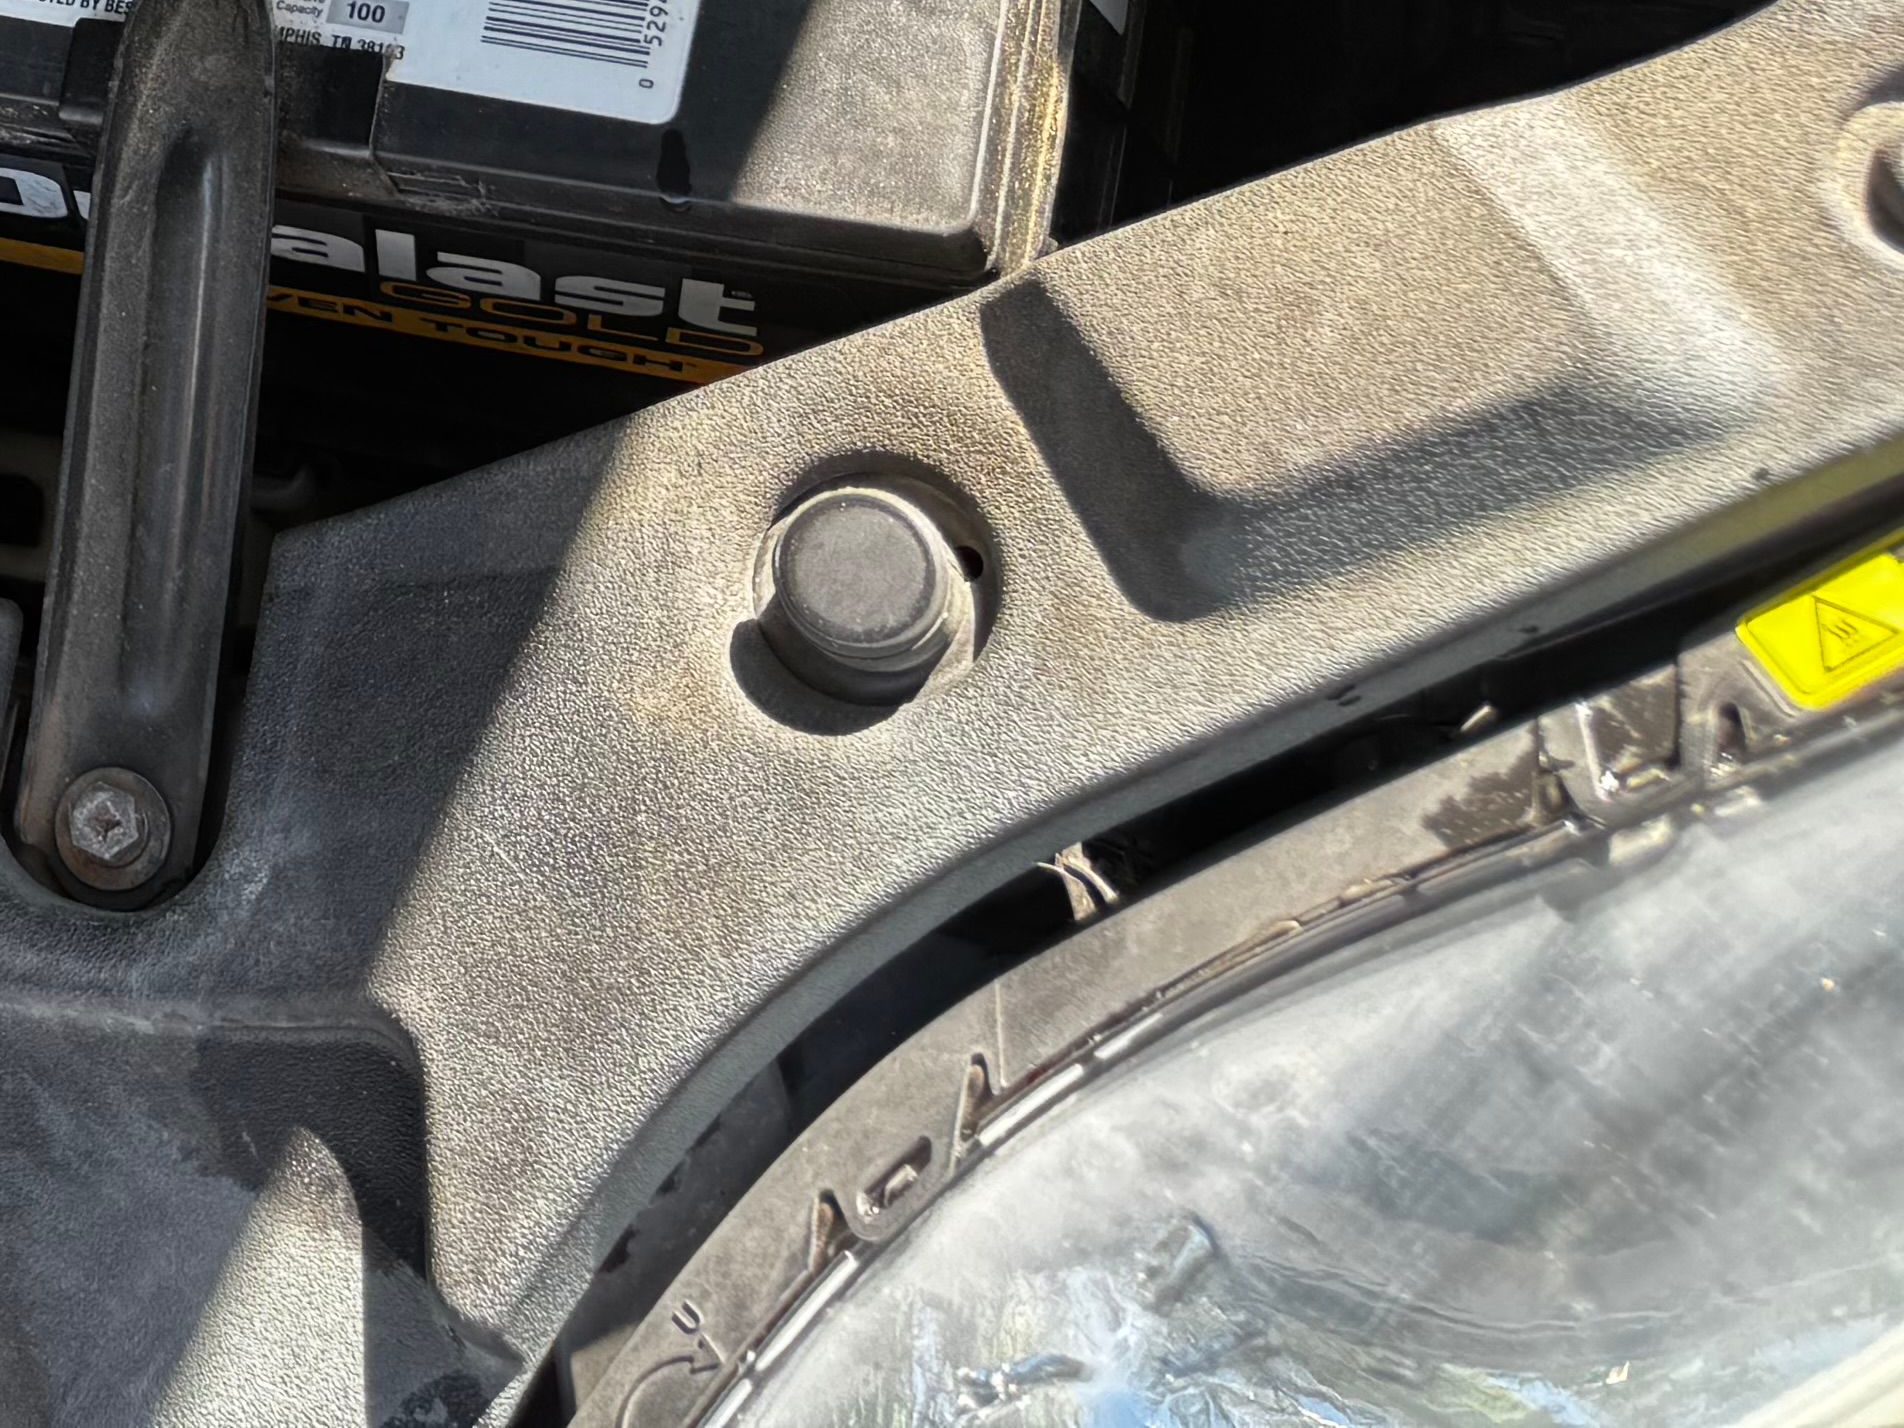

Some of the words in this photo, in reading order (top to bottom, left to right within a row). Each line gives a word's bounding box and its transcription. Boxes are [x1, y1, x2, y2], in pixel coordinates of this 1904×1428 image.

[275, 0, 323, 17] Capacity
[346, 1, 386, 23] 100
[639, 77, 654, 89] 0
[379, 281, 765, 357] GOLD
[420, 317, 684, 373] TOUGH
